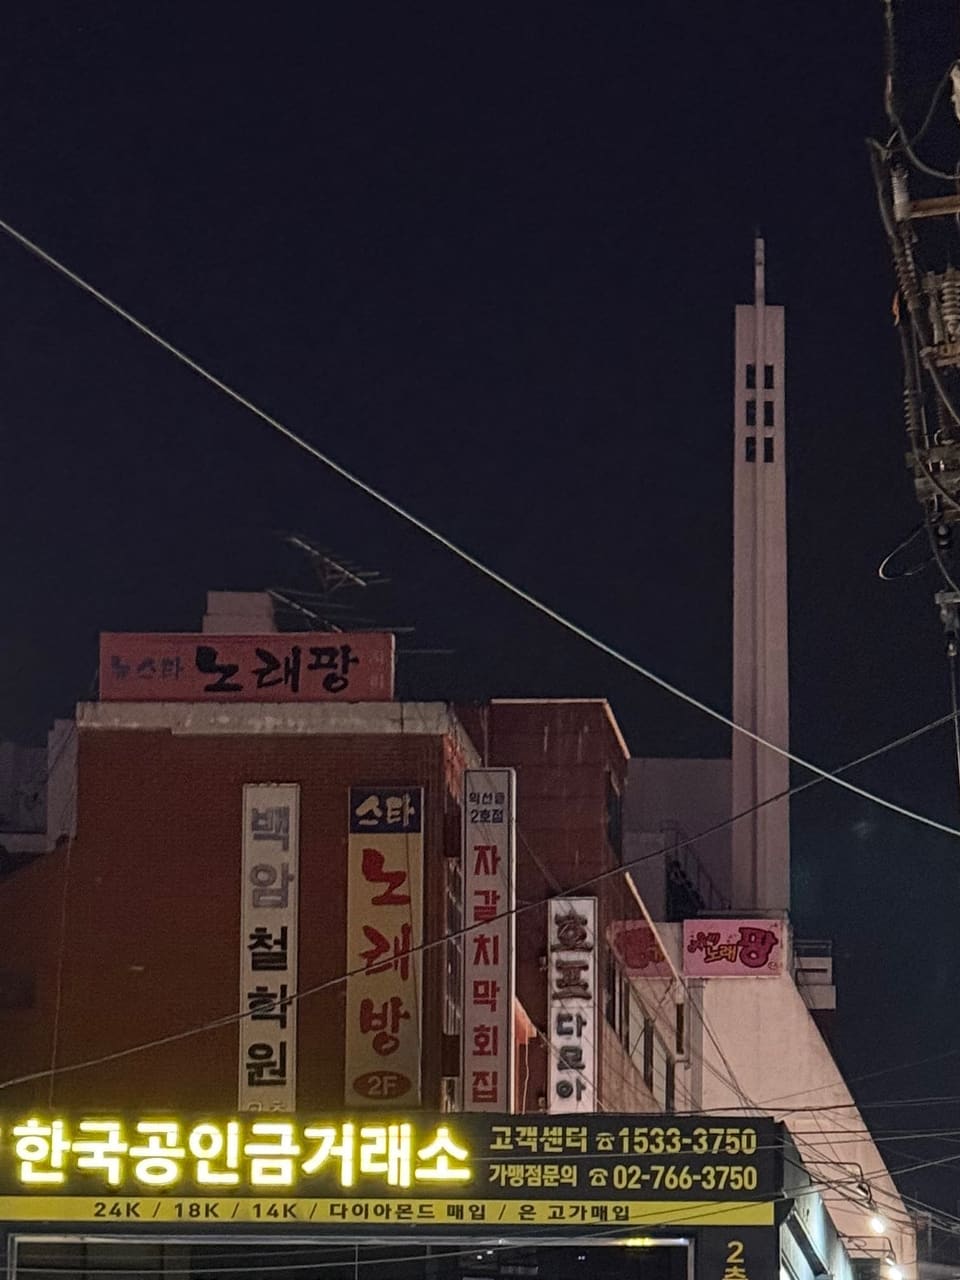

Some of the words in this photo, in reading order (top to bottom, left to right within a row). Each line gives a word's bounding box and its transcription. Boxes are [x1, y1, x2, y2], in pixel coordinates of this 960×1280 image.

[196, 645, 359, 694] 노래팡
[356, 796, 415, 826] 스타
[359, 848, 412, 1057] 노래방
[472, 844, 501, 1104] 자갈치막회집
[367, 1076, 399, 1096] 2F
[12, 1118, 471, 1188] 한국공인금거래소
[489, 1126, 588, 1154] 고객센터
[619, 1126, 757, 1155] 1533-3750
[489, 1165, 577, 1189] 가맹점문의
[613, 1165, 758, 1191] 02-766-3750
[94, 1202, 141, 1218] 24K
[175, 1202, 219, 1218] 18K
[253, 1203, 298, 1219] 14K
[329, 1203, 436, 1221] 다이아몬드
[446, 1204, 487, 1221] 매입
[517, 1205, 537, 1221] 은
[547, 1205, 631, 1222] 고가매입
